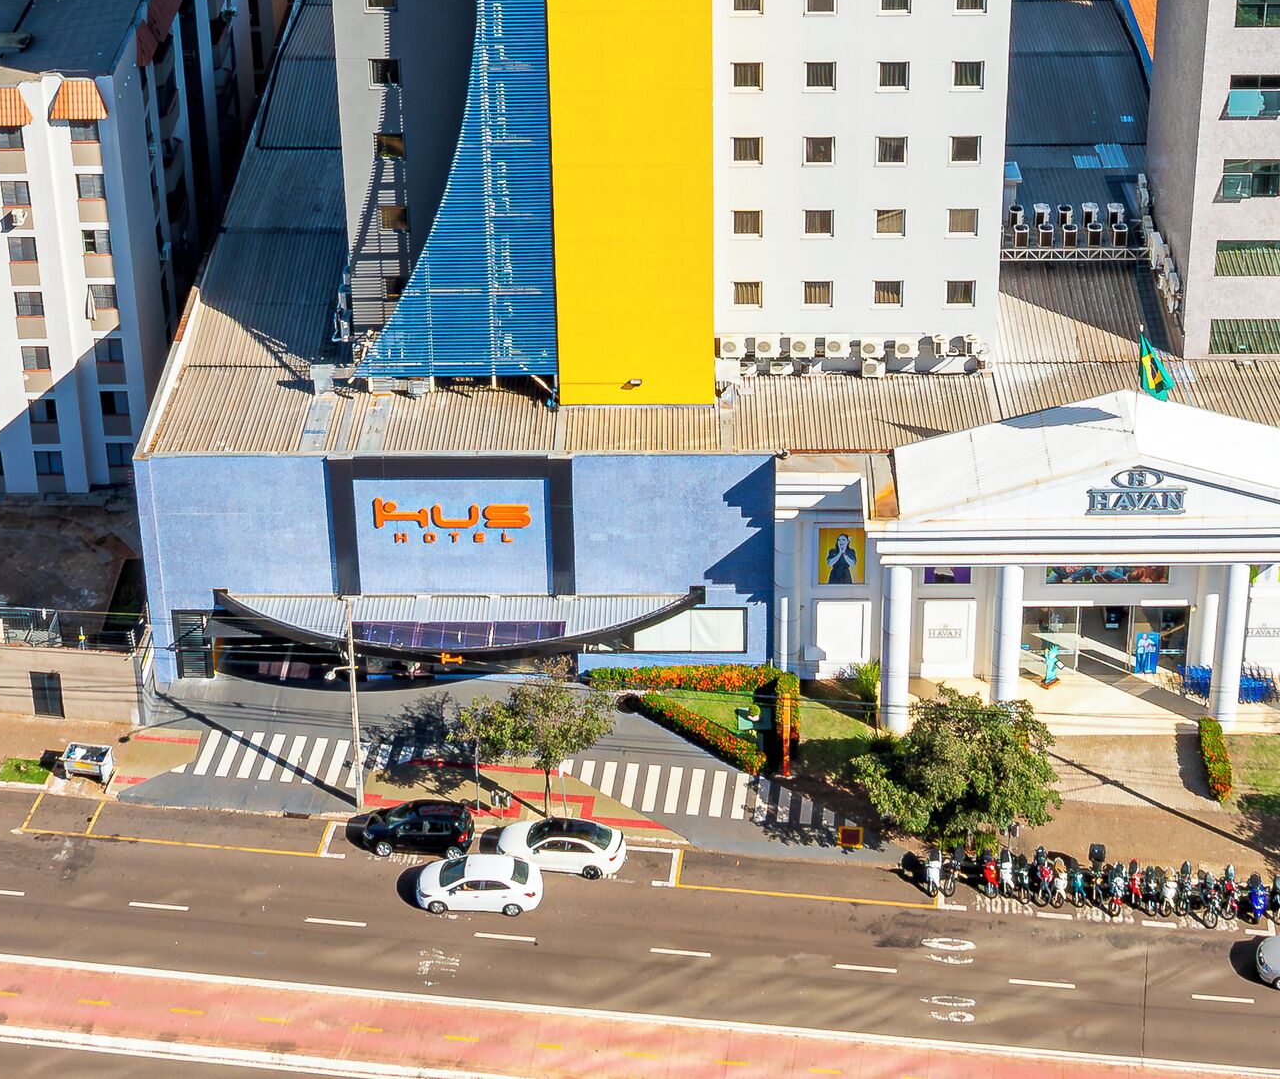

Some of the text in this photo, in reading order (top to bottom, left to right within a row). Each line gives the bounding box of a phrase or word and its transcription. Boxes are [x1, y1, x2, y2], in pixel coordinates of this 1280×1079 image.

[1086, 489, 1187, 514] HAVAN
[393, 531, 514, 544] HOTEL
[928, 628, 962, 639] HAVAN
